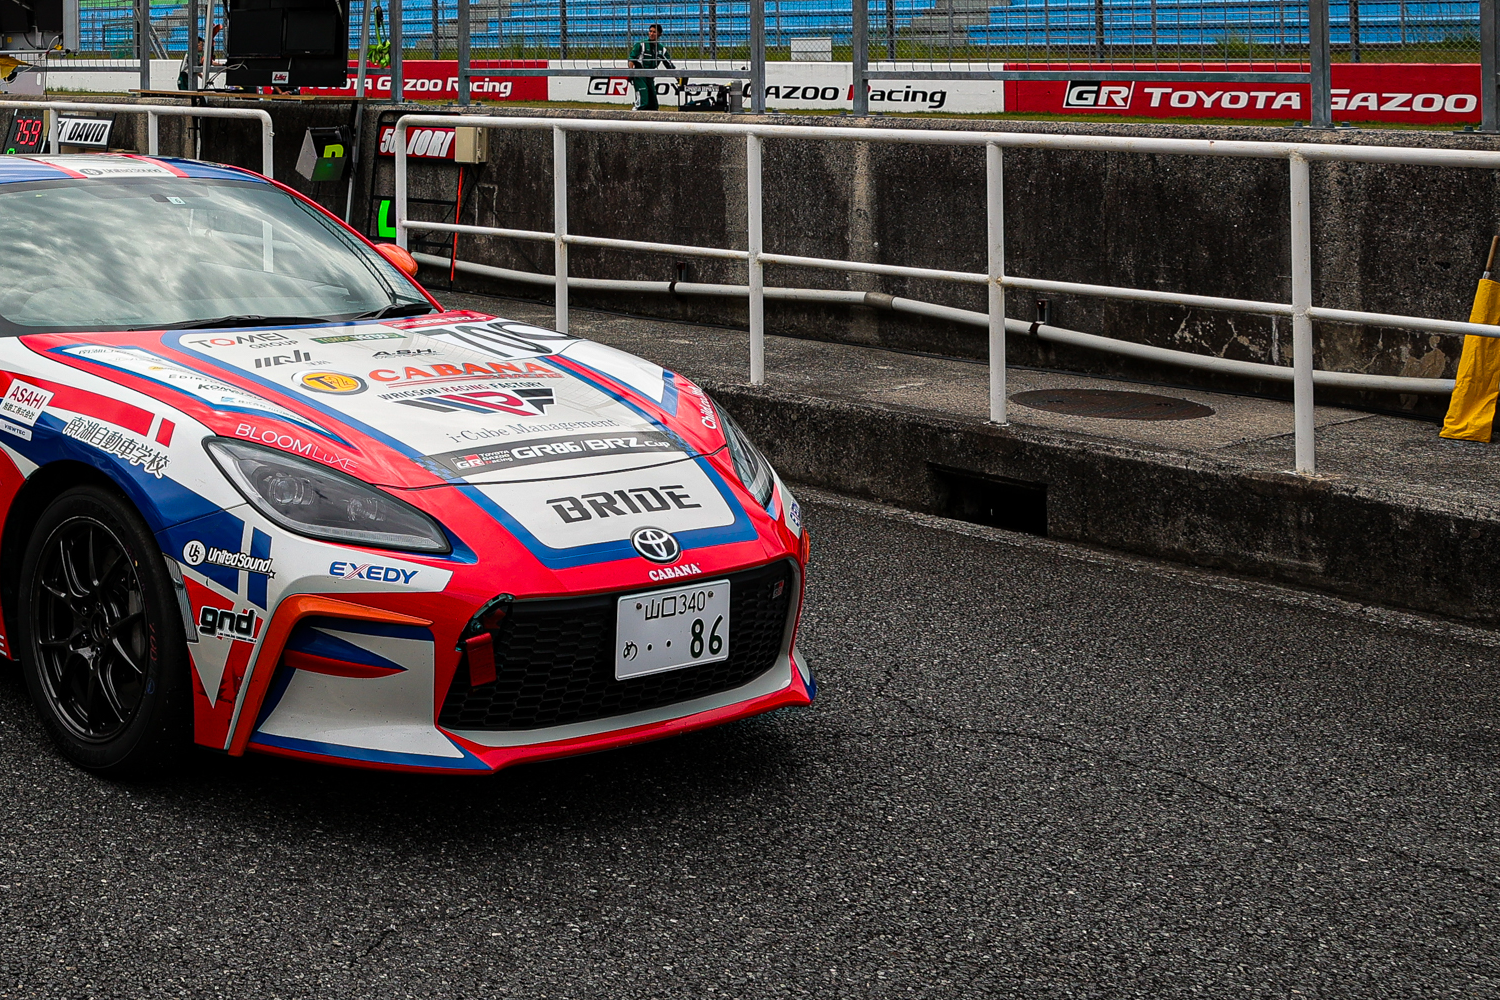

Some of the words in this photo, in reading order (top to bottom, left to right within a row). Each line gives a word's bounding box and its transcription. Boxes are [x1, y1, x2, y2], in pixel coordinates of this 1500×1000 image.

[1067, 84, 1131, 107] GR
[1143, 87, 1300, 111] TOYOTA
[16, 119, 41, 146] 759
[68, 121, 109, 143] DAVID
[407, 129, 456, 157] IORI
[188, 332, 289, 349] TOMEI
[248, 338, 299, 349] GROUP
[369, 361, 555, 382] CABANA
[8, 385, 48, 410] ASAHI
[377, 385, 439, 401] WRIGSON
[440, 382, 490, 394] RACING
[489, 380, 545, 391] FACTORY
[4, 423, 26, 436] VIEWTEC
[235, 422, 313, 455] BLOOM
[446, 425, 512, 444] i-Cube
[514, 417, 620, 436] Management
[63, 416, 171, 479] 南湖自動車学校
[455, 457, 484, 470] GR
[512, 436, 646, 460] GR86/BRZ
[645, 439, 671, 450] Cup
[478, 449, 510, 459] TOYOTA
[481, 453, 511, 461] GAZOO
[484, 457, 514, 465] Racing
[546, 484, 703, 525] BRIDE
[329, 560, 419, 585] EXEDY
[648, 562, 702, 582] CABANA
[198, 606, 257, 638] gnd
[690, 614, 724, 659] 86
